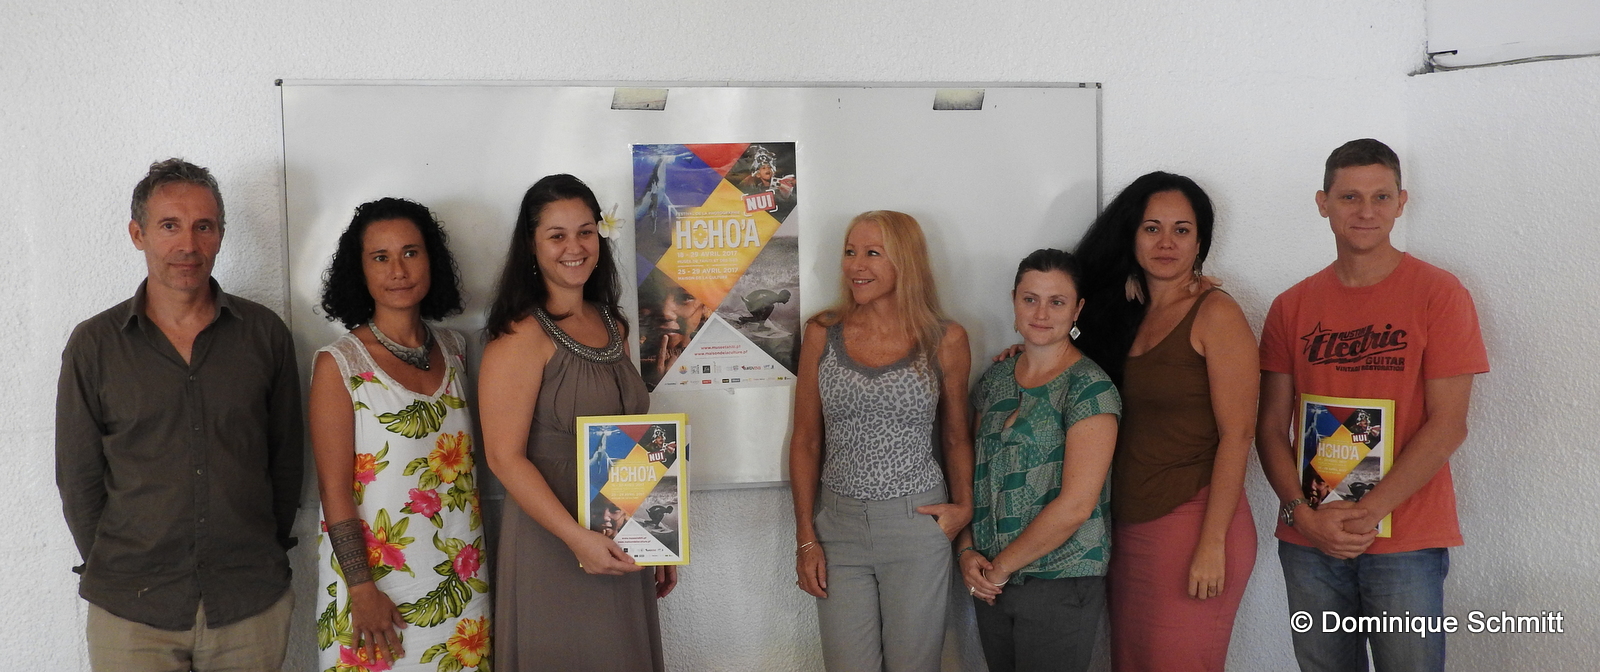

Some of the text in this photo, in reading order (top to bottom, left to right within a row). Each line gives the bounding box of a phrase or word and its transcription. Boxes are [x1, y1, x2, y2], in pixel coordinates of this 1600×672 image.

[746, 194, 773, 211] NUI
[675, 219, 760, 249] HOHO'A
[1308, 324, 1407, 362] Electric
[1365, 357, 1405, 365] GUITAR
[1353, 434, 1367, 442] NUI
[649, 452, 664, 461] NUI
[611, 465, 657, 482] HOHO'A
